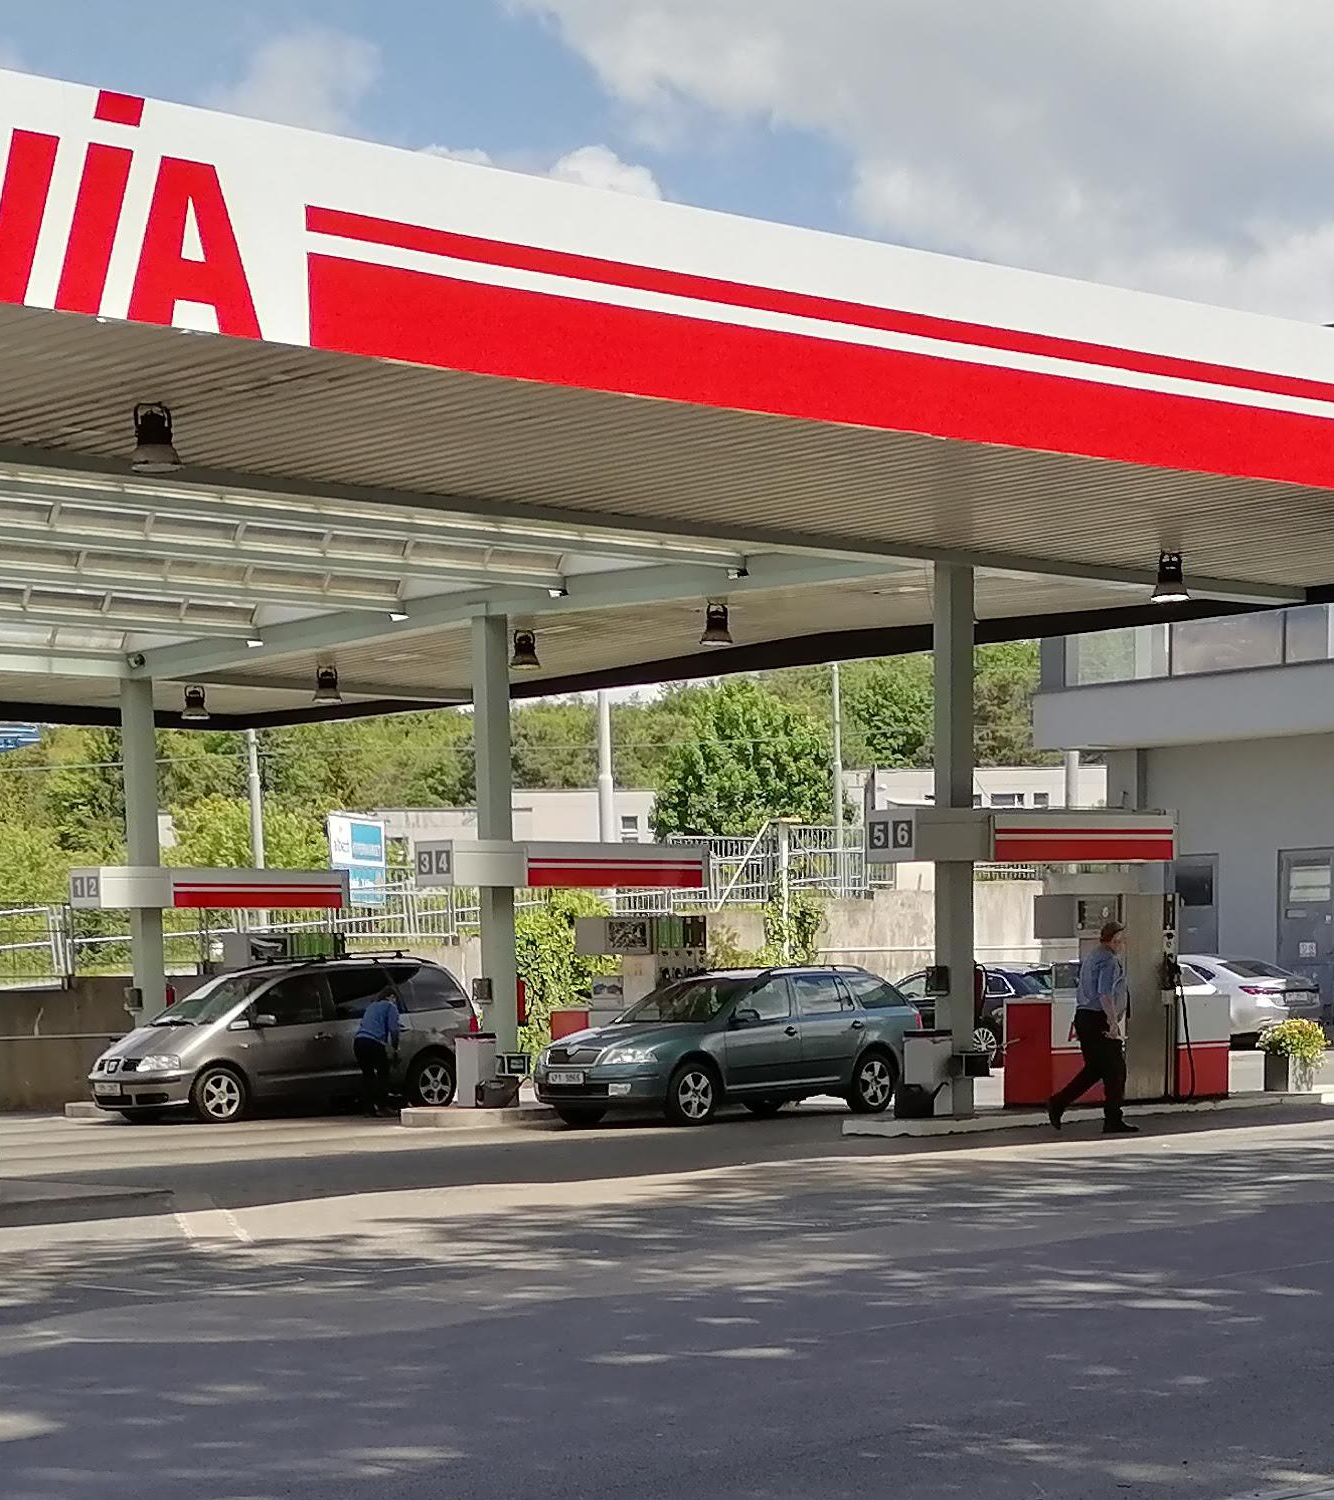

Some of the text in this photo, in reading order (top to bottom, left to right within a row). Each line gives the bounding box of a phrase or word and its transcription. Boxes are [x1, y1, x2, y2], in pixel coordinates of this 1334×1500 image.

[873, 823, 909, 847] 5 6
[420, 852, 448, 873] 3 4
[89, 878, 98, 896] 2
